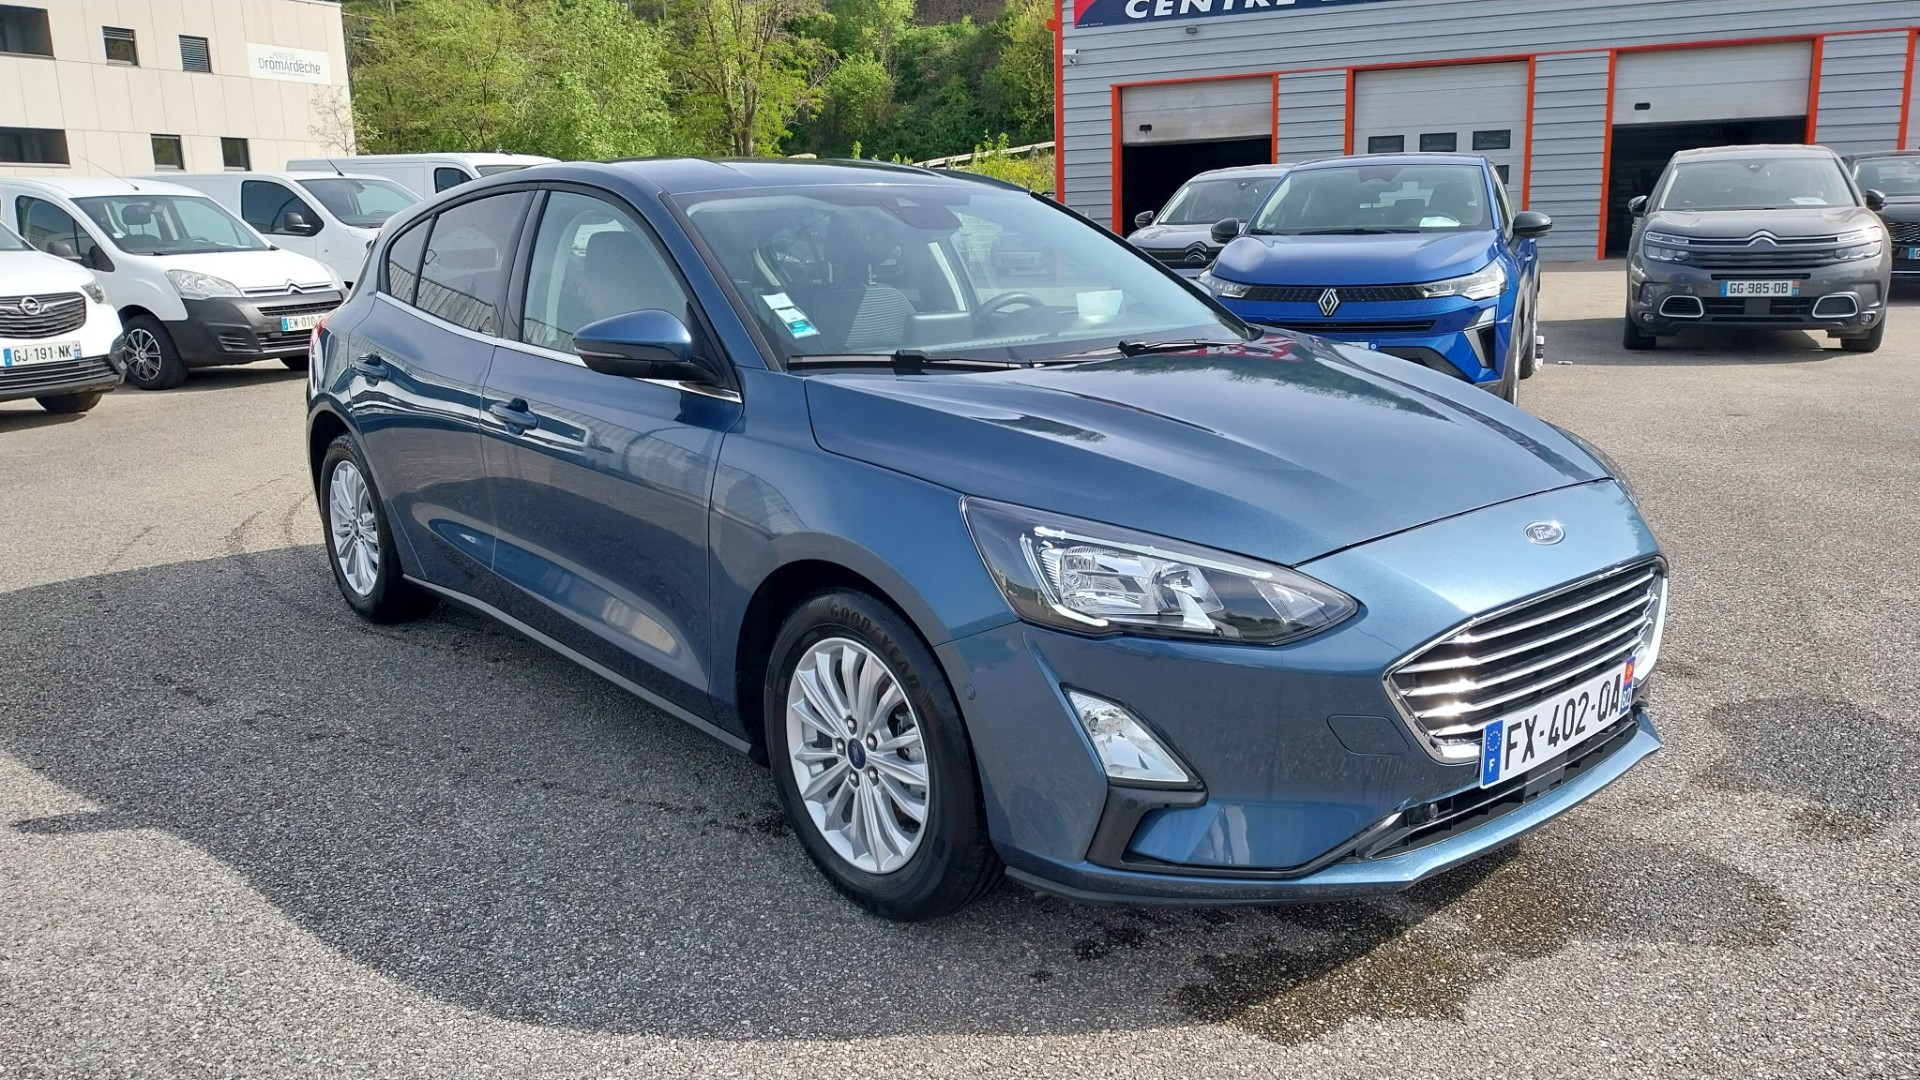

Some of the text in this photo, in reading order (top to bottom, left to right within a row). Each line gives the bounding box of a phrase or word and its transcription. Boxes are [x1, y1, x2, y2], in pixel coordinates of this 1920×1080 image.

[1125, 0, 1296, 18] CEN
[1504, 673, 1622, 771] FX-402-QA
[1488, 758, 1496, 772] F
